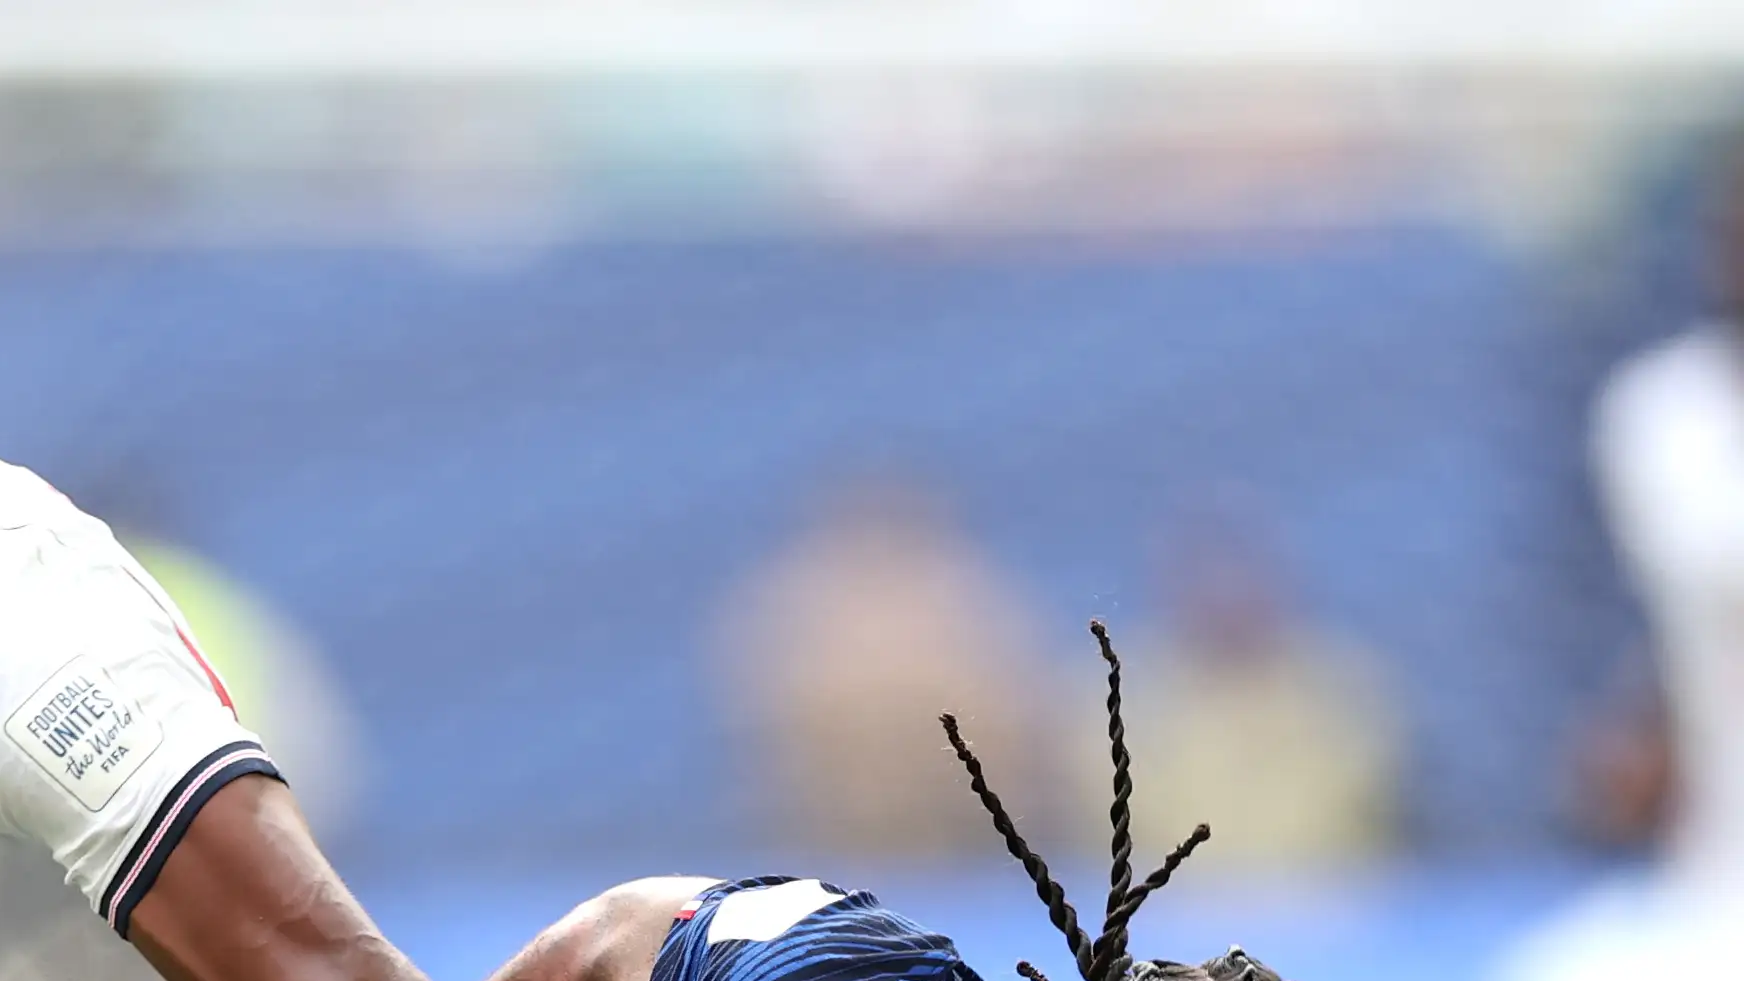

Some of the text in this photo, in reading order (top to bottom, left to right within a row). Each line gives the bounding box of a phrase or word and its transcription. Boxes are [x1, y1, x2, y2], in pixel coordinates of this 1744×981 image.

[27, 676, 95, 739] FOOTBALL
[43, 689, 113, 758] UNITES
[65, 705, 133, 781] the World
[101, 745, 130, 773] FIFA
